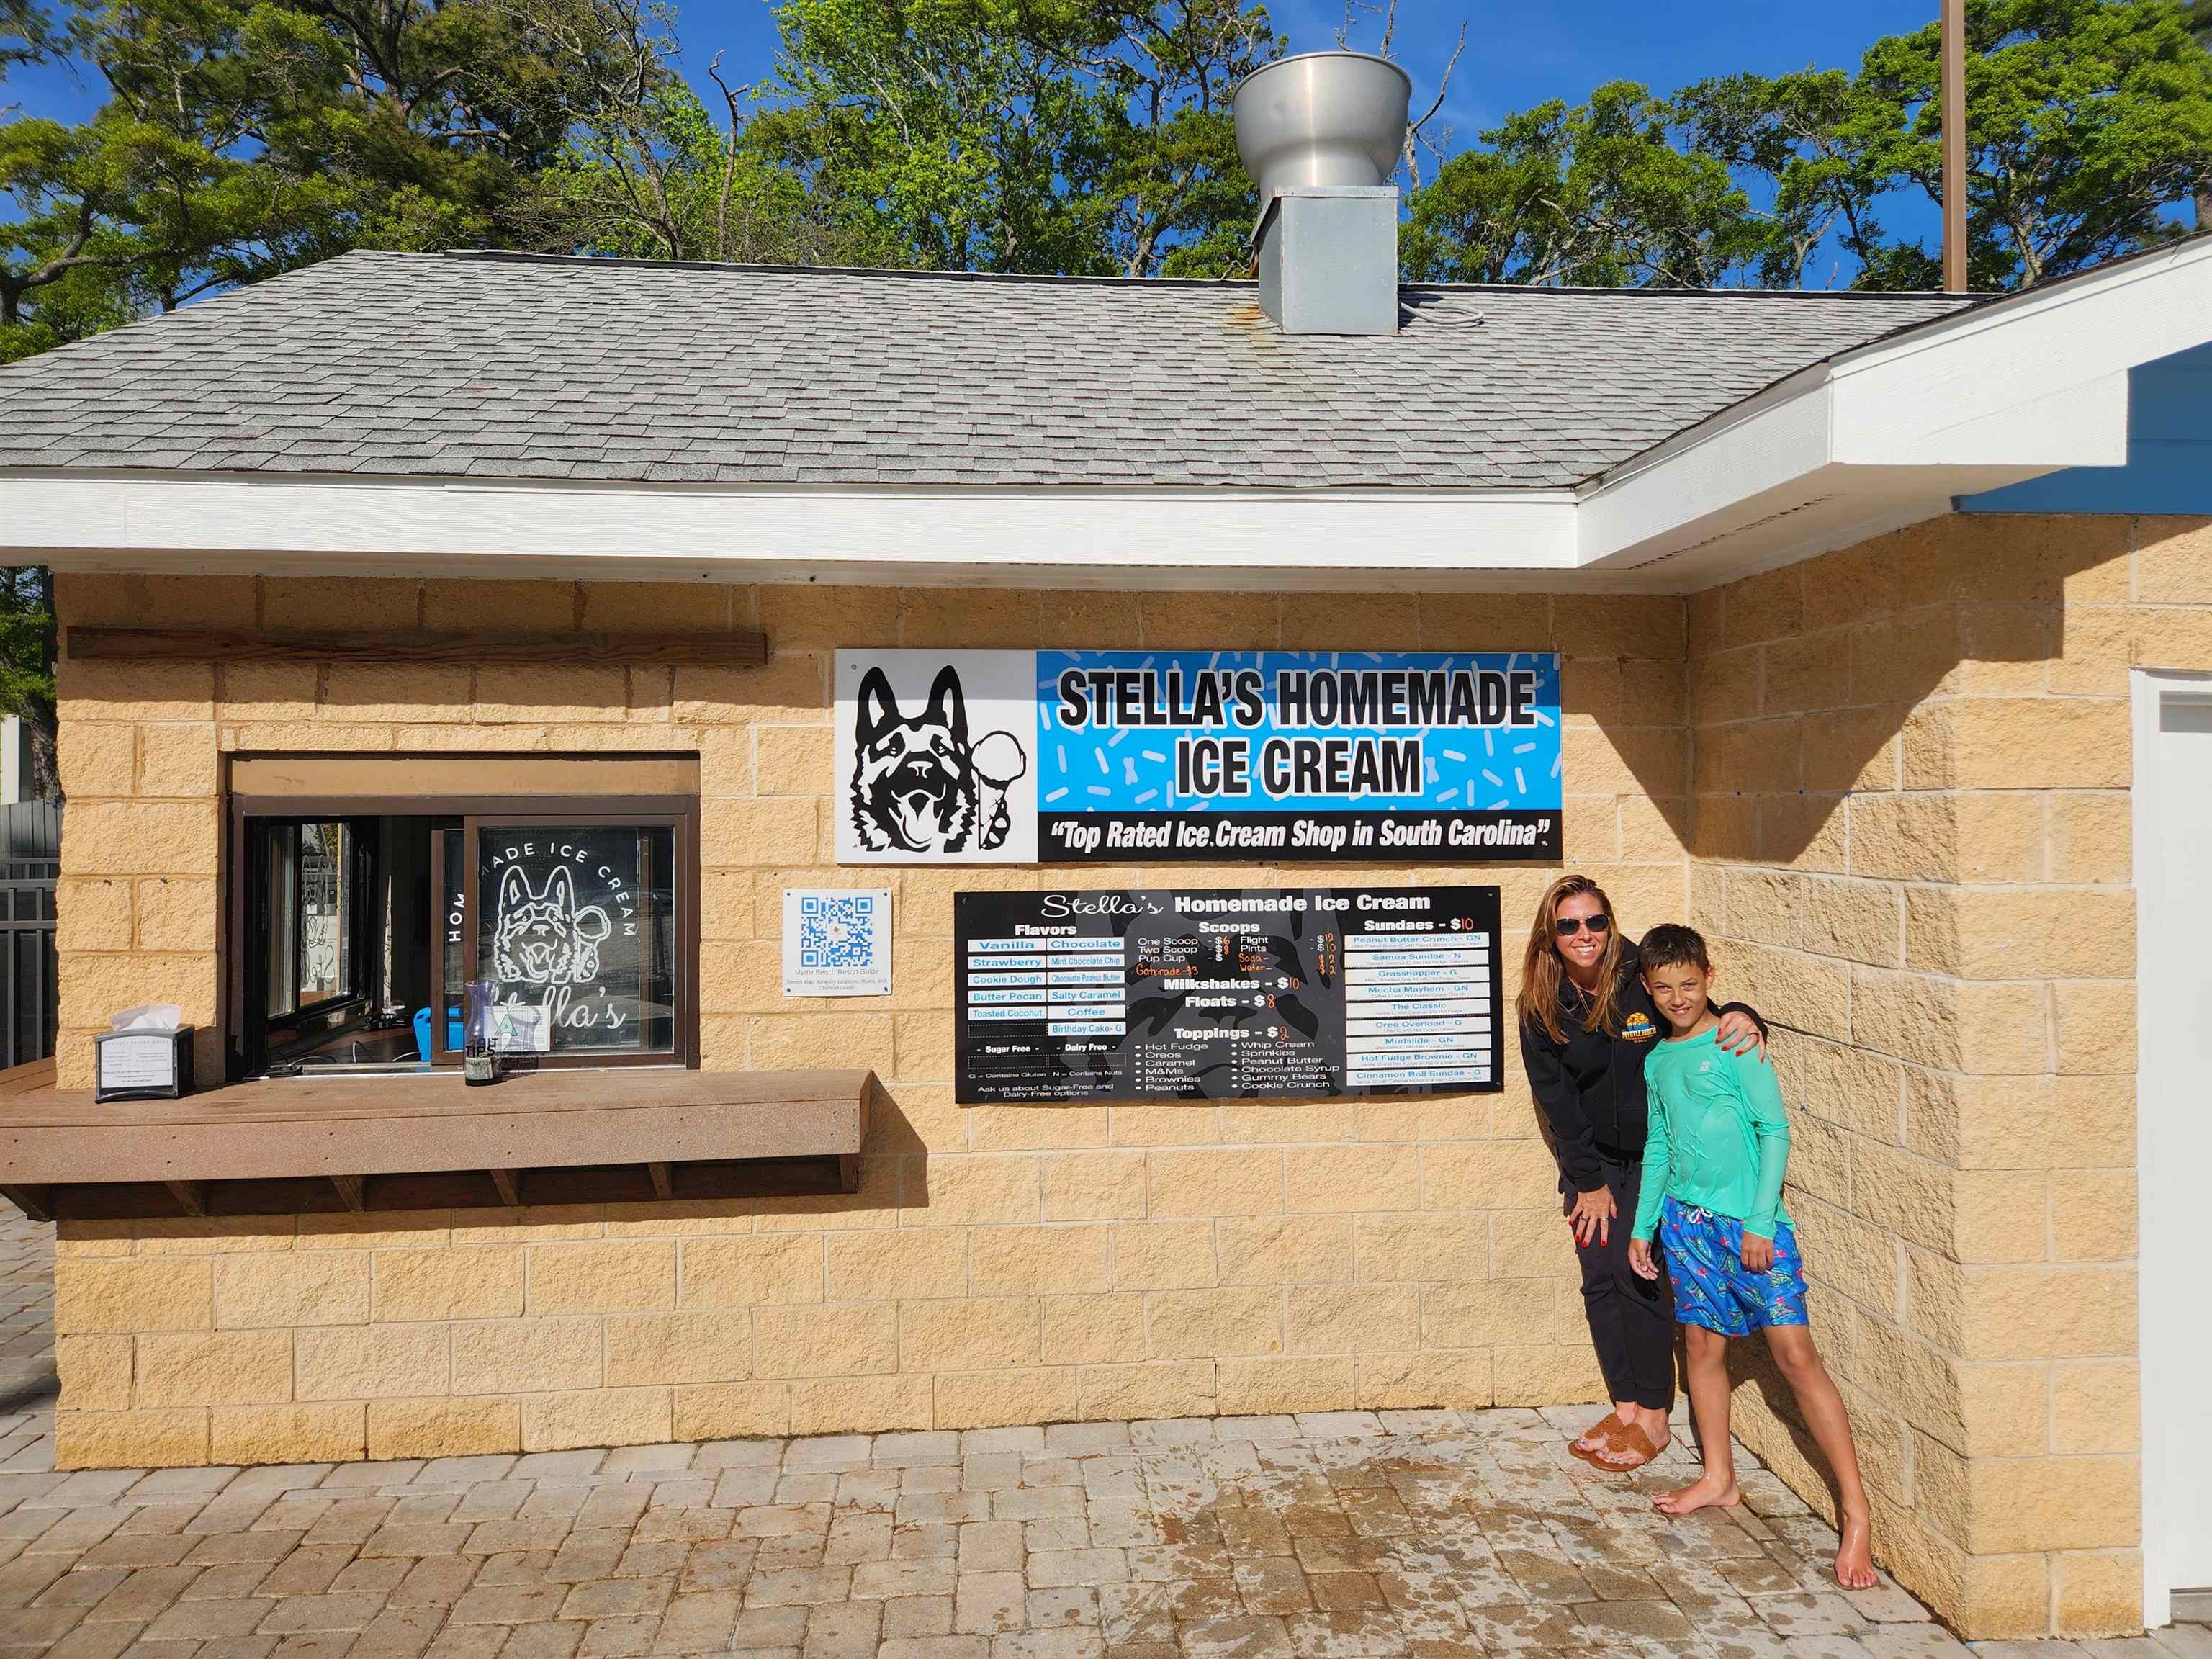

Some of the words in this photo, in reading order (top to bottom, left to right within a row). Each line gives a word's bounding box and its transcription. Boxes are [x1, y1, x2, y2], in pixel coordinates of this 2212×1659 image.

[1058, 669, 1264, 727] STELLA'S
[1277, 670, 1537, 727] HOMEMADE
[1177, 738, 1249, 796] ICE
[1262, 738, 1422, 796] CREAM
[1106, 821, 1172, 848] Rated
[1175, 821, 1211, 848] Ice
[1215, 820, 1286, 848] Cream
[1291, 819, 1347, 852] Shop
[1352, 819, 1372, 846] in
[1379, 819, 1443, 847] South
[550, 842, 588, 863] ICE
[598, 866, 635, 935] CREAM
[1041, 895, 1164, 918] Stella's
[1174, 896, 1308, 912] Homemade
[1315, 895, 1350, 911] Ice
[1357, 894, 1431, 910] Cream
[1198, 922, 1260, 935] Scoops
[1364, 920, 1434, 931] Sundaes
[1450, 917, 1474, 931] $10
[1015, 925, 1077, 936] Flavors
[979, 941, 1035, 950] Vanilla
[1051, 940, 1120, 948] Chocolate
[1163, 938, 1199, 946] Scoop
[1240, 936, 1269, 945] Flight
[1138, 945, 1160, 954] Two
[1163, 945, 1197, 955] Scoop
[973, 958, 1042, 968] Strawberry
[1105, 956, 1120, 965] Chip
[1138, 955, 1160, 963] Pup
[1163, 954, 1186, 963] Cup
[1010, 975, 1042, 984] Dough
[1164, 977, 1260, 990] Milkshakes
[1277, 976, 1300, 991] $10
[1009, 992, 1042, 1001] Pecan
[1052, 992, 1077, 1000] Salty
[1079, 990, 1121, 999] Caramel
[1185, 995, 1237, 1007] Floats
[1254, 993, 1277, 1008] $8
[1052, 1025, 1087, 1033] Birthday
[1174, 1028, 1250, 1040] Toppings
[985, 1046, 1010, 1054] Sugar
[1171, 1043, 1209, 1051] Fudge
